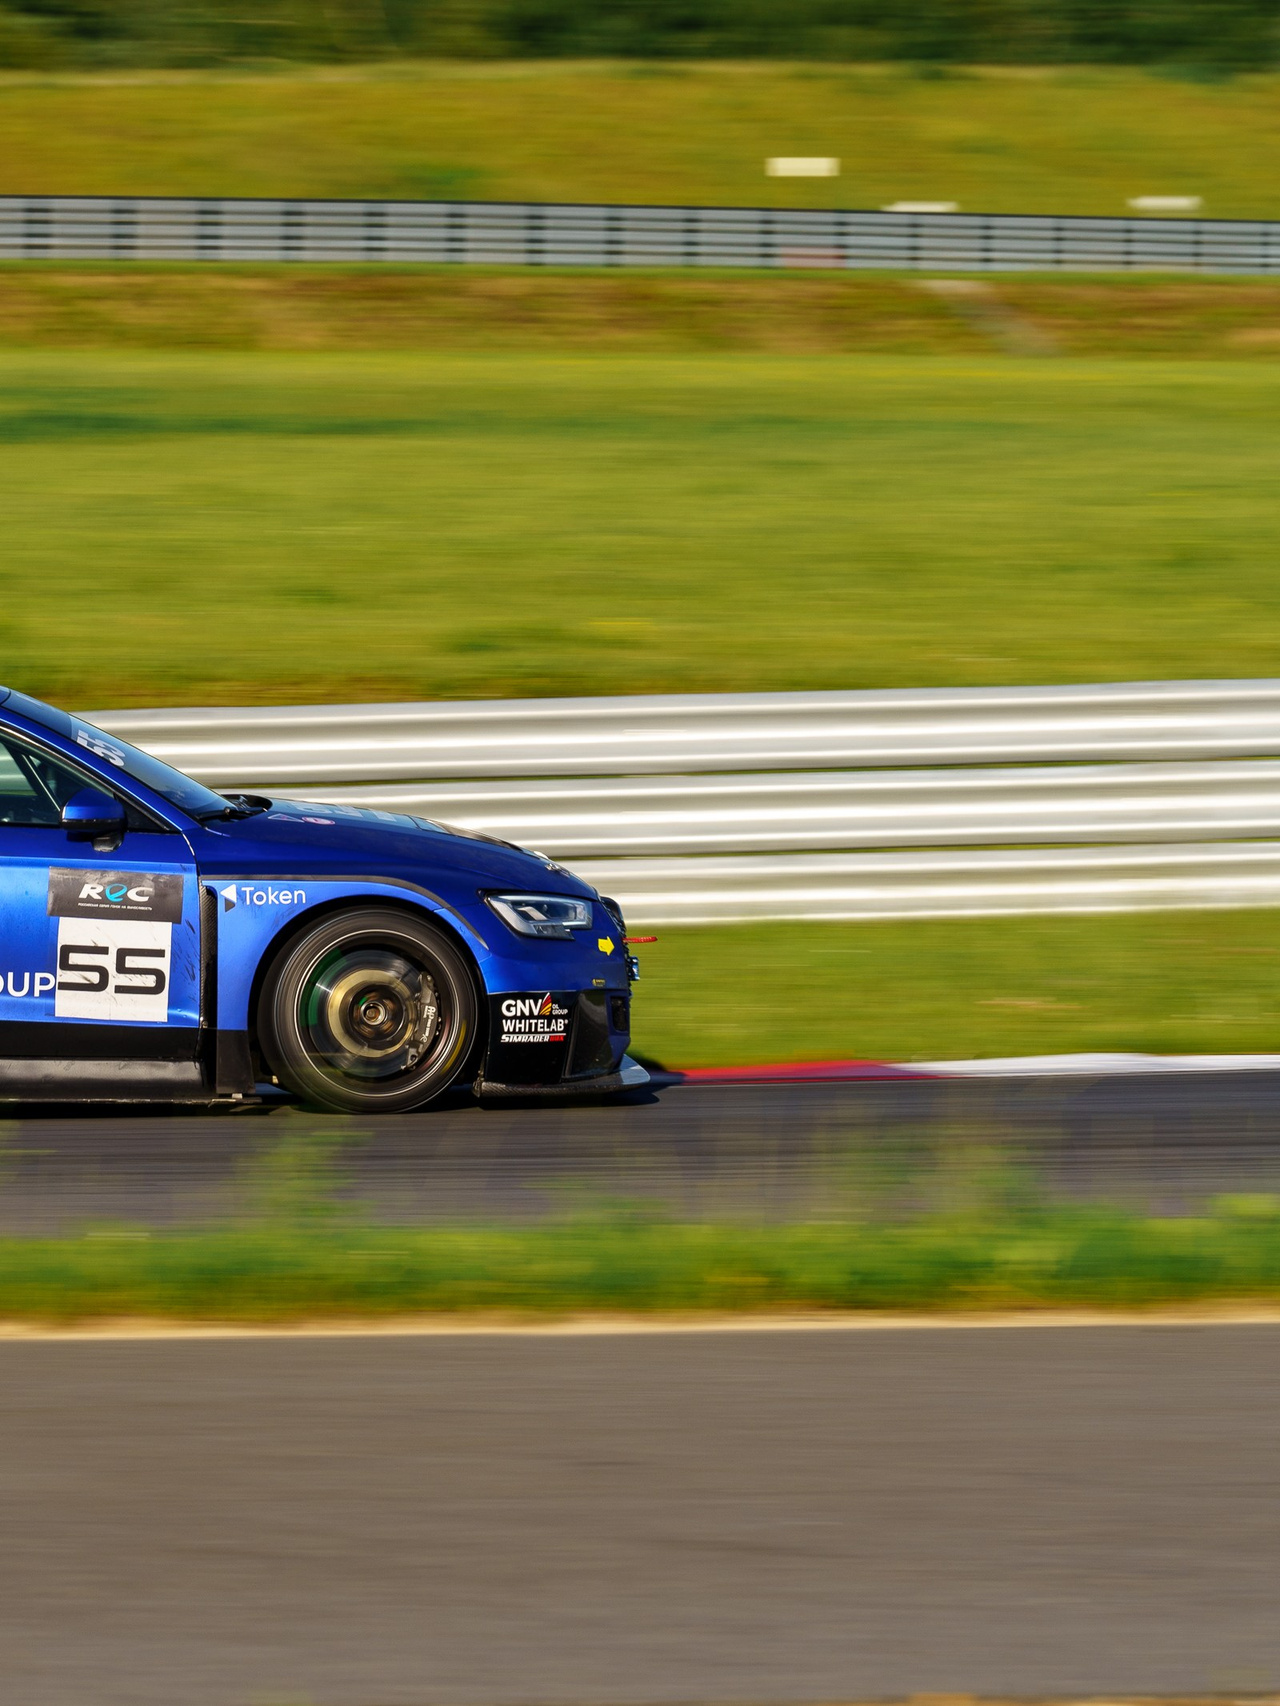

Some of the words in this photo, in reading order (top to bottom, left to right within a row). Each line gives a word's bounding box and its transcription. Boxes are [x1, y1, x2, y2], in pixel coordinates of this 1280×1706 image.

[241, 886, 306, 906] Token
[58, 944, 166, 995] 55
[501, 999, 542, 1017] GNV
